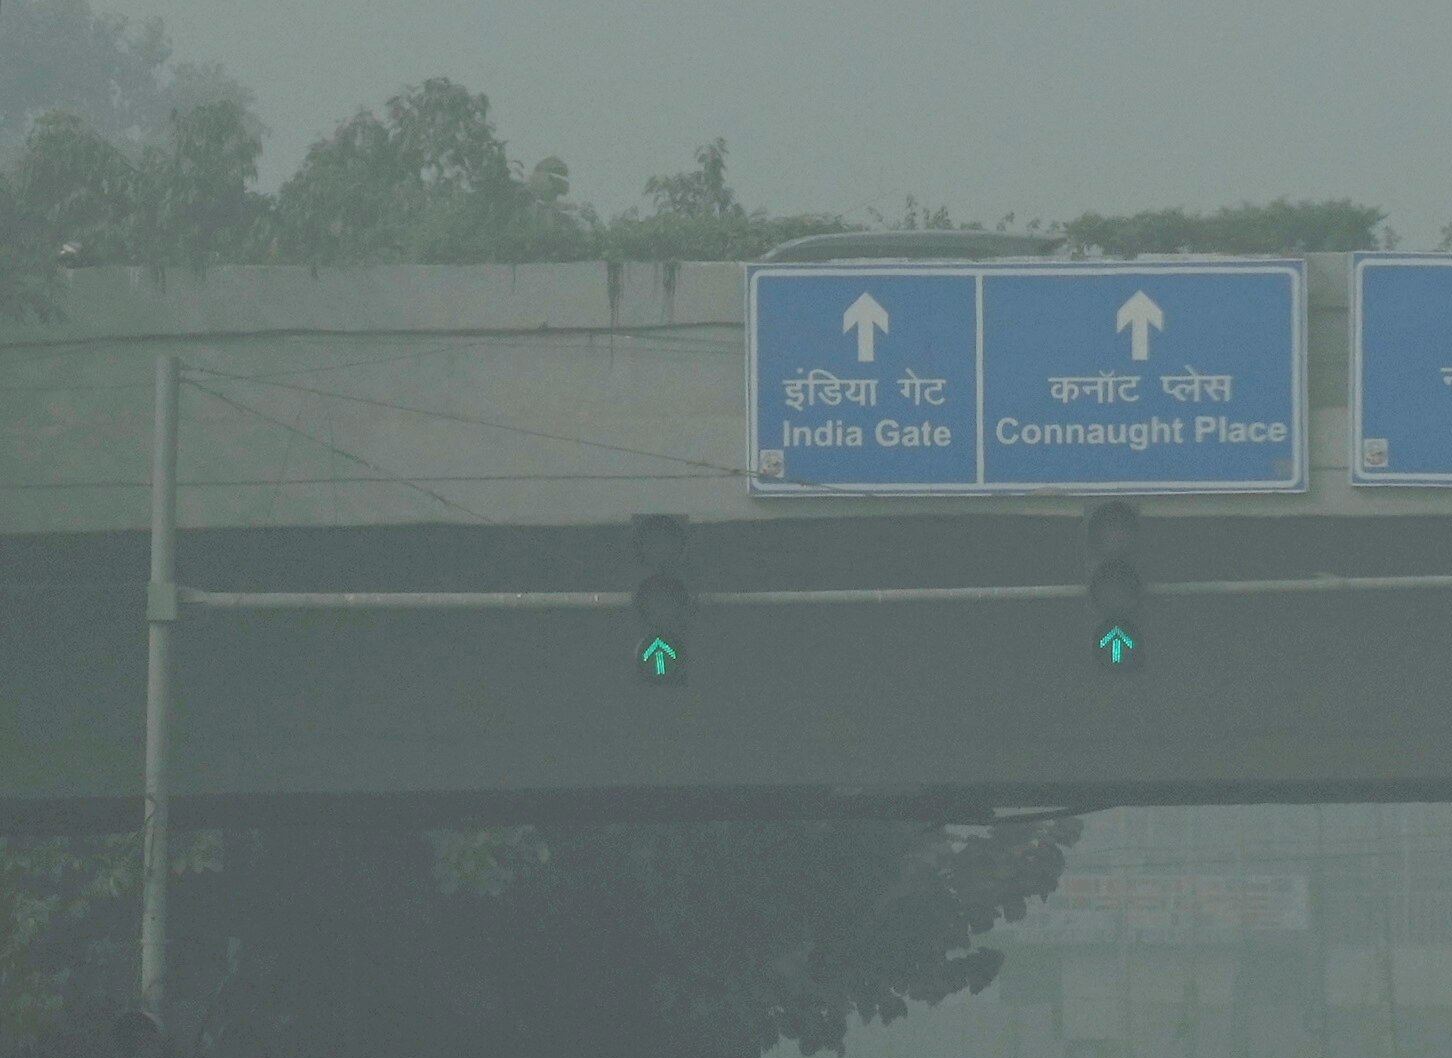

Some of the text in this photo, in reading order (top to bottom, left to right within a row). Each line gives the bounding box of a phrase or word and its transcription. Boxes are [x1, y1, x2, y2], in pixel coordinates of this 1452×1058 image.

[782, 367, 948, 412] इंडिया गेट
[1048, 364, 1233, 404] कनॉट प्लेस
[782, 419, 952, 447] India Gate
[995, 416, 1288, 450] Connaught Place
